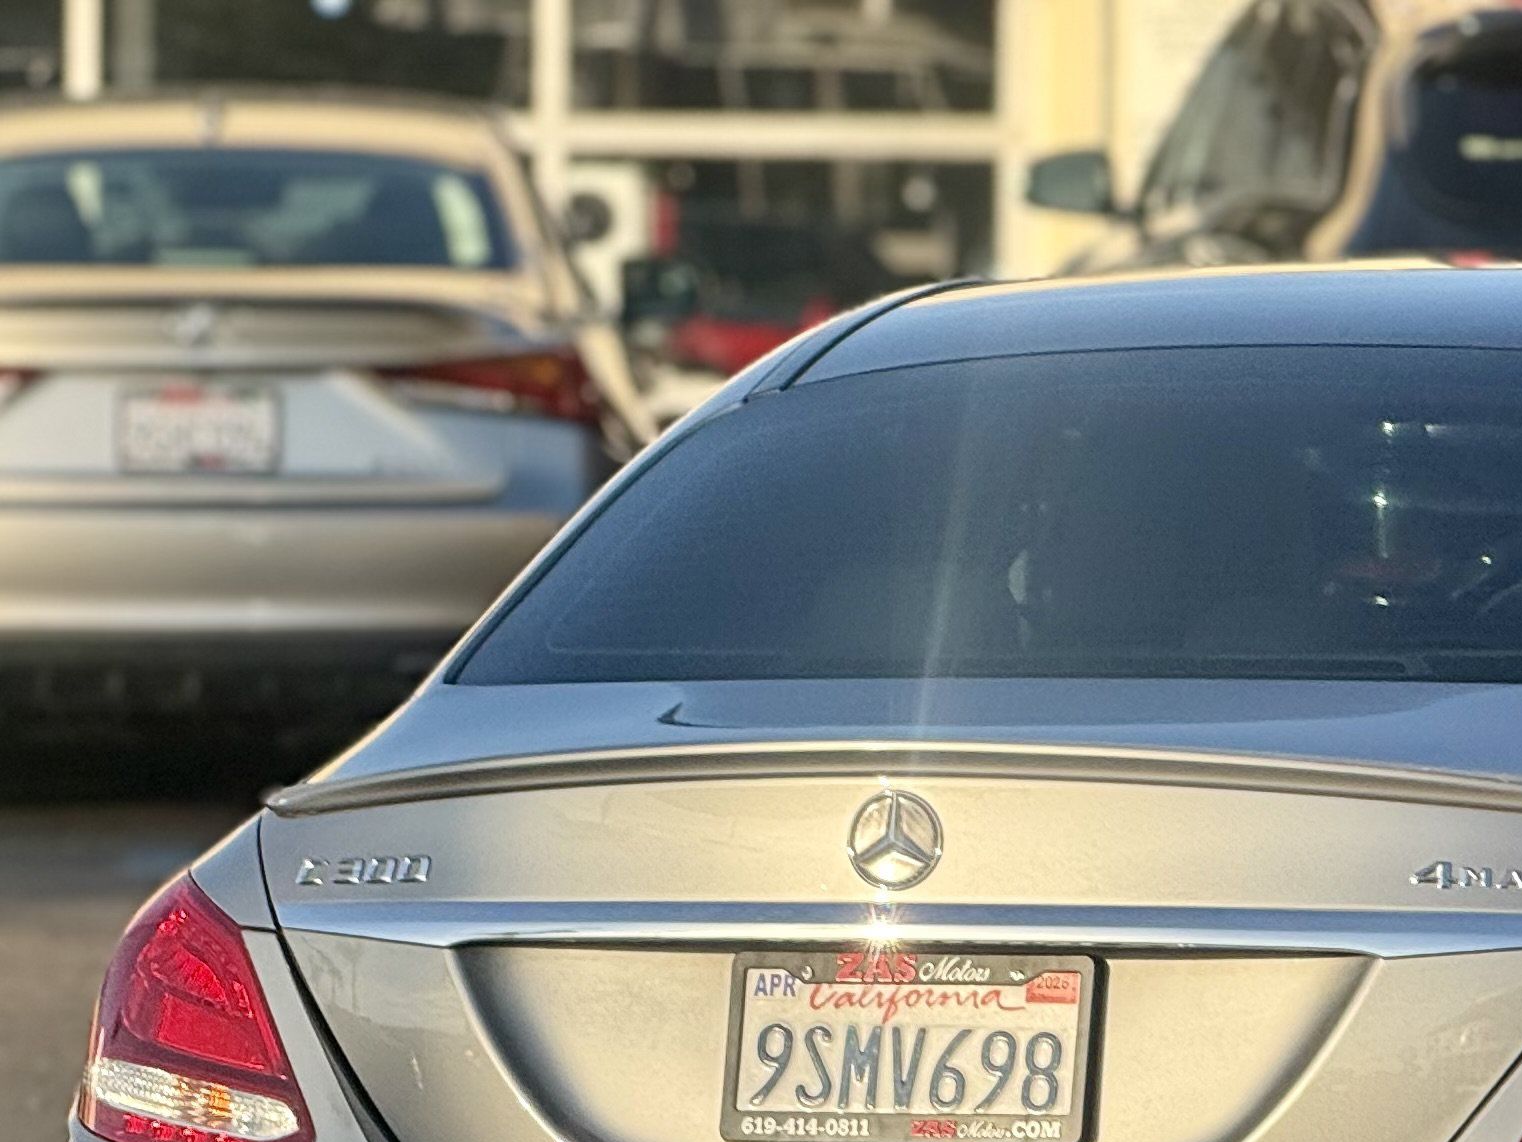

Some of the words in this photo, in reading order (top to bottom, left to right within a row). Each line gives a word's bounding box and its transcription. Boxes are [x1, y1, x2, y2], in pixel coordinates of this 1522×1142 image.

[333, 854, 431, 884] 300
[835, 952, 917, 983] ZAS
[754, 973, 797, 997] APR
[809, 981, 1026, 1024] California
[749, 1023, 1062, 1114] 9SMV698
[740, 1116, 870, 1137] 619-414-0811
